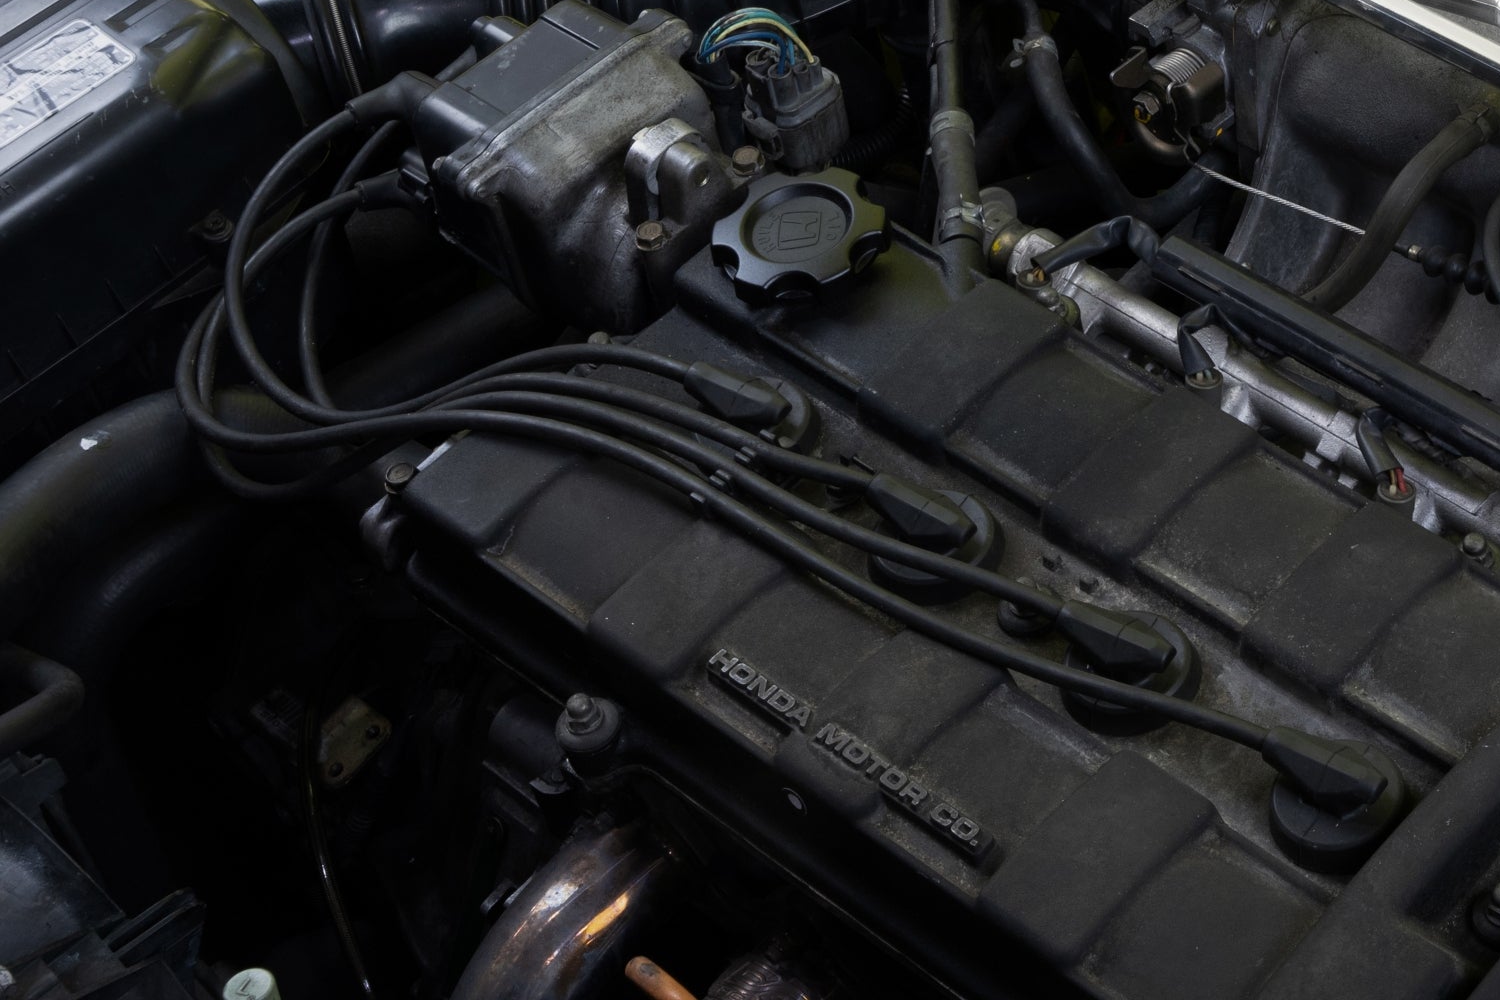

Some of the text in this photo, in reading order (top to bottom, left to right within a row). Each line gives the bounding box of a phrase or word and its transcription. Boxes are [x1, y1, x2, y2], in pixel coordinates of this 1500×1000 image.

[708, 648, 981, 846] HONDA MOTOR CO.
